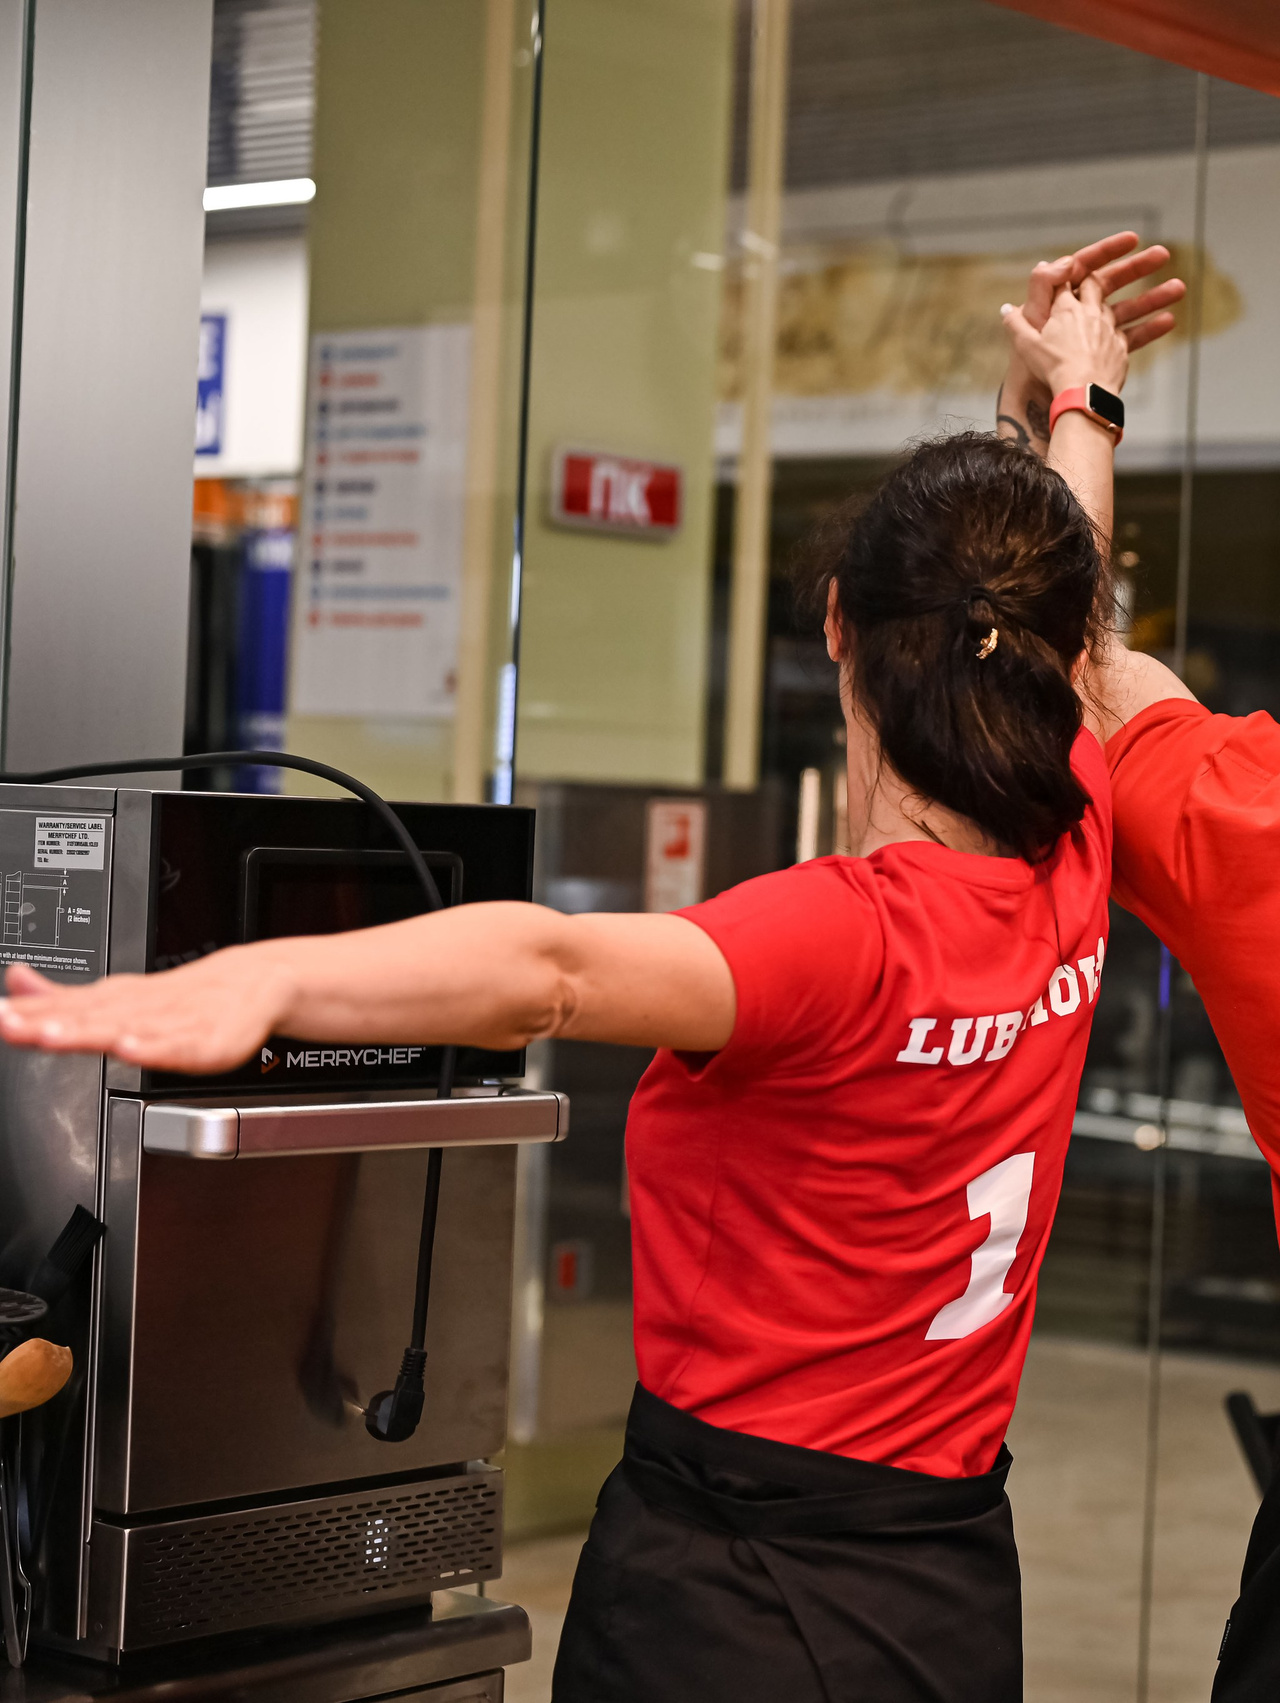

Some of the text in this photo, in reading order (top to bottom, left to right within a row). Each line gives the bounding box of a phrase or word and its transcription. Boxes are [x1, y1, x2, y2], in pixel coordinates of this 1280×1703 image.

[38, 822, 86, 830] WARRANTY/SERVICE
[76, 907, 91, 916] 50mm
[68, 915, 91, 925] (2 inches)
[17, 952, 26, 960] least
[33, 954, 52, 962] minimum
[53, 956, 72, 964] clearance
[73, 957, 88, 965] shown.
[286, 1047, 423, 1068] MERRYCHEF
[924, 1150, 1036, 1341] 1
